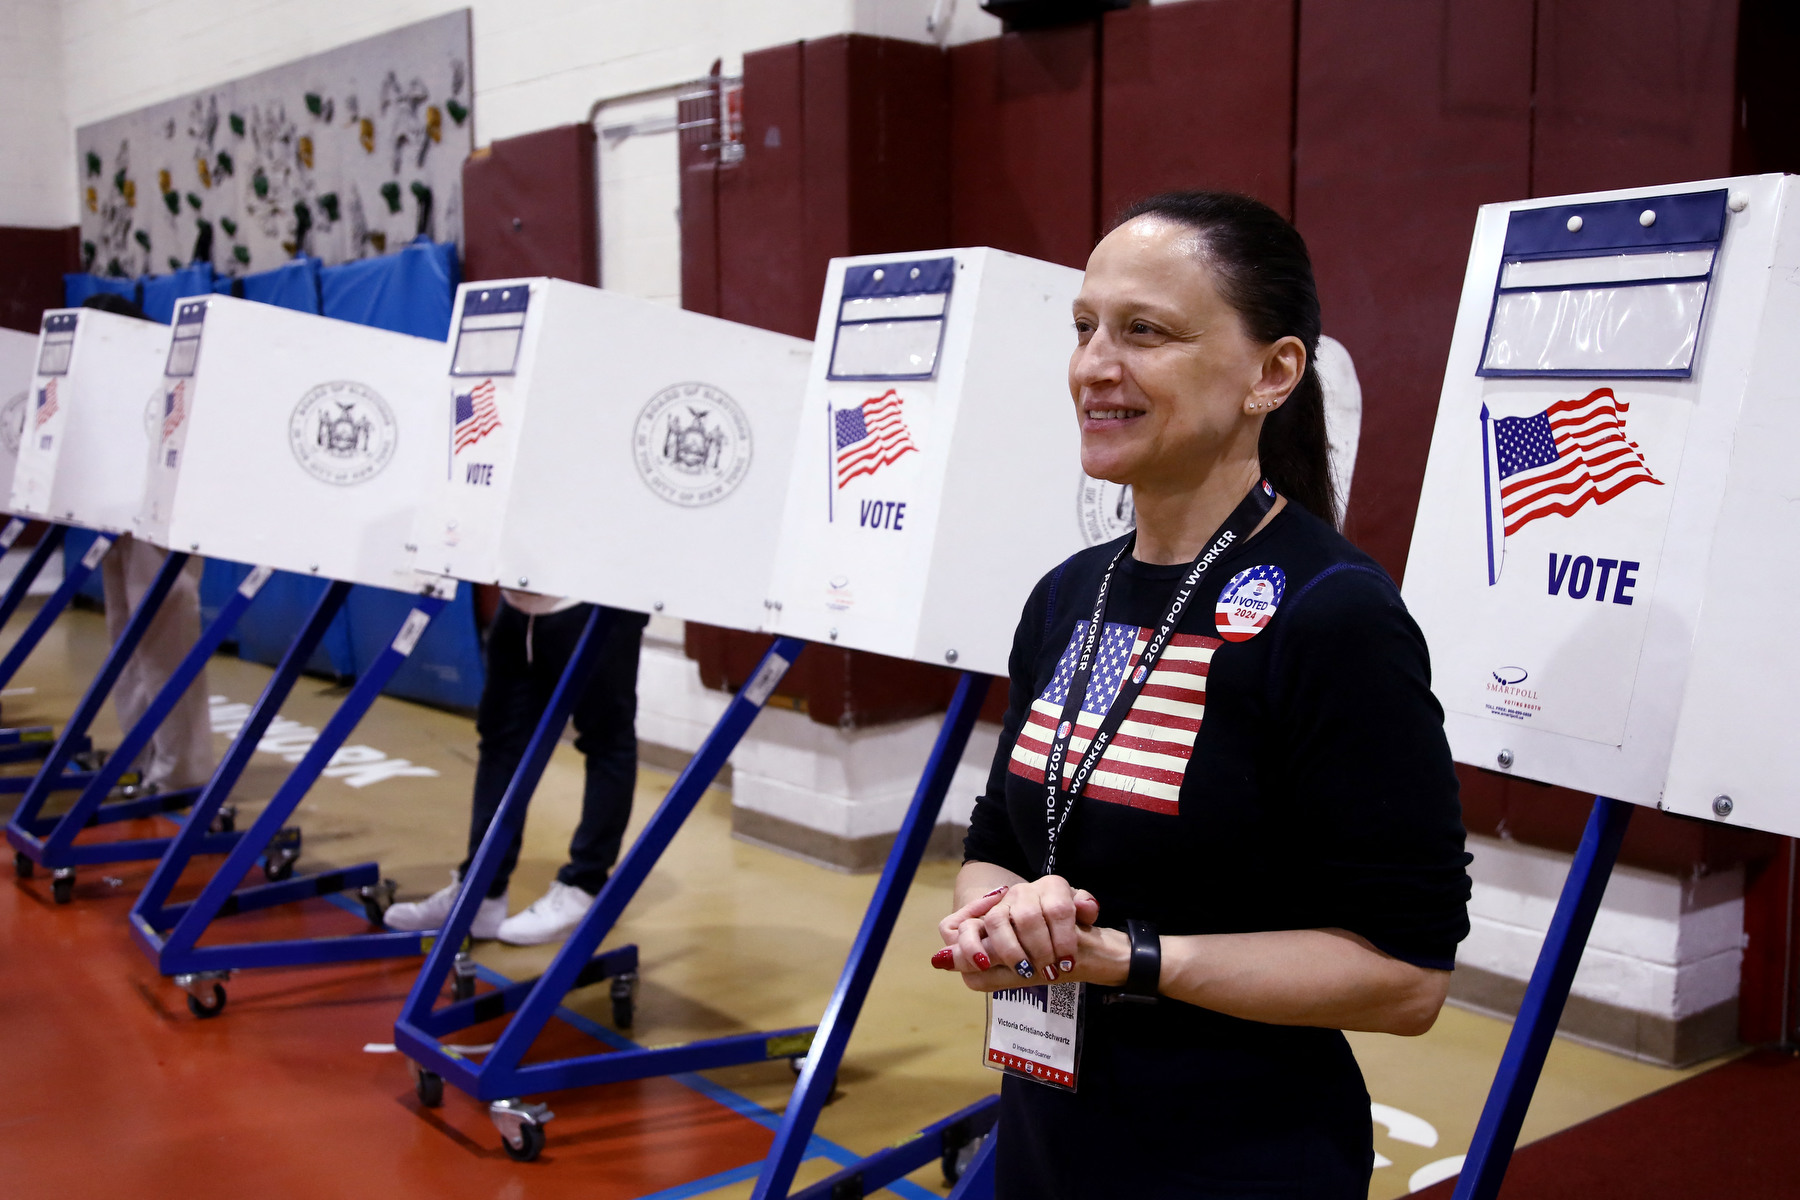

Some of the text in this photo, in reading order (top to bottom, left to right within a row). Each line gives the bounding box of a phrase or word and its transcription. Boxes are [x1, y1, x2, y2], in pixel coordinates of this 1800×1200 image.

[466, 463, 494, 486] VOTE
[860, 499, 907, 531] VOTE
[1097, 573, 1111, 607] POLL
[1548, 552, 1640, 606] VOTE
[1145, 530, 1238, 663] 2024 POLL WORKER
[1239, 597, 1269, 611] VOTED
[1234, 608, 1257, 620] 2024
[1078, 608, 1102, 672] WORKER
[1486, 682, 1538, 700] SMARTPOLL
[1047, 743, 1063, 782] 2024
[1070, 731, 1109, 794] WORKER
[1046, 786, 1056, 823] POLL
[998, 1017, 1070, 1045] Victoria Cristiano-Schwartz
